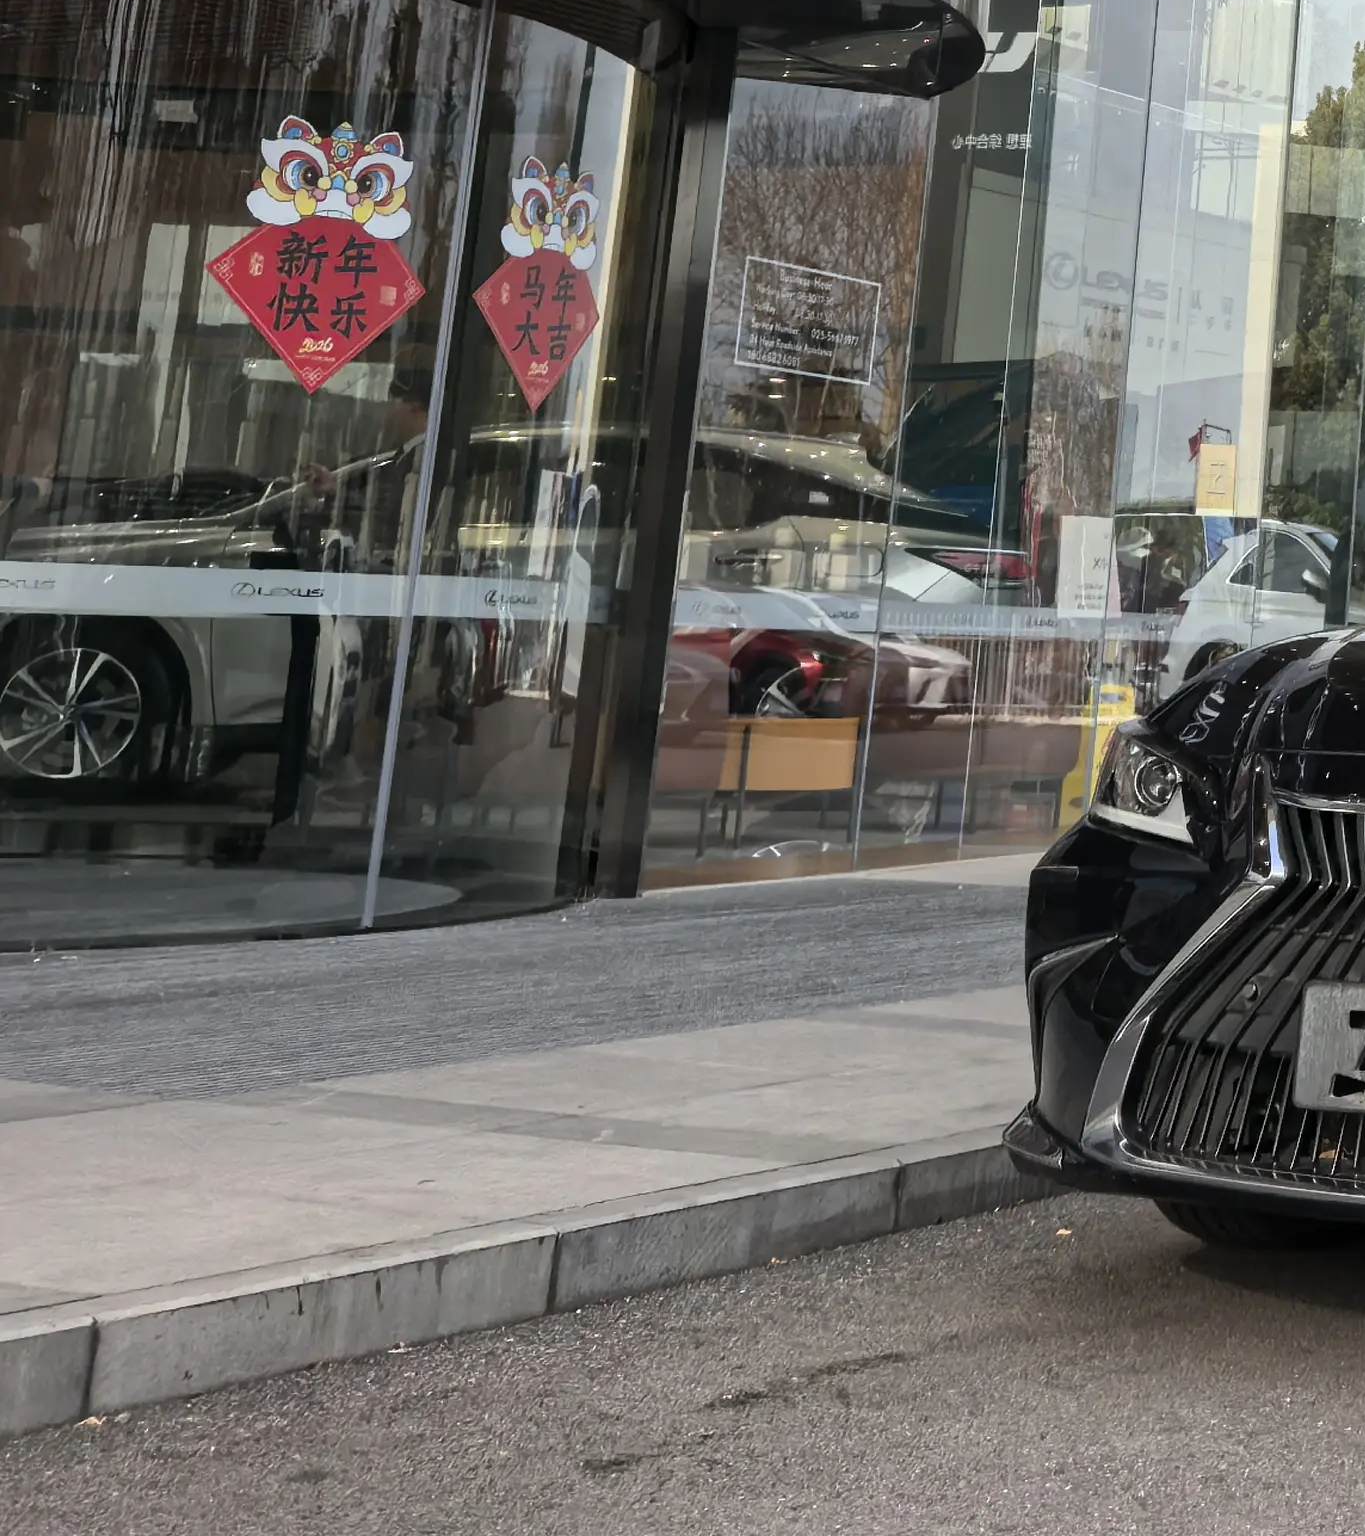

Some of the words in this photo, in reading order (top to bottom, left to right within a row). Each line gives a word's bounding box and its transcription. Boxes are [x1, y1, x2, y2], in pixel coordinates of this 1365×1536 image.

[276, 231, 378, 289] 新年
[520, 265, 577, 322] 马年
[780, 269, 810, 288] Business
[267, 282, 367, 339] 快乐
[298, 336, 334, 353] 2026
[511, 311, 573, 361] 大吉
[0, 578, 56, 590] EXUS
[258, 585, 325, 598] LEXUS
